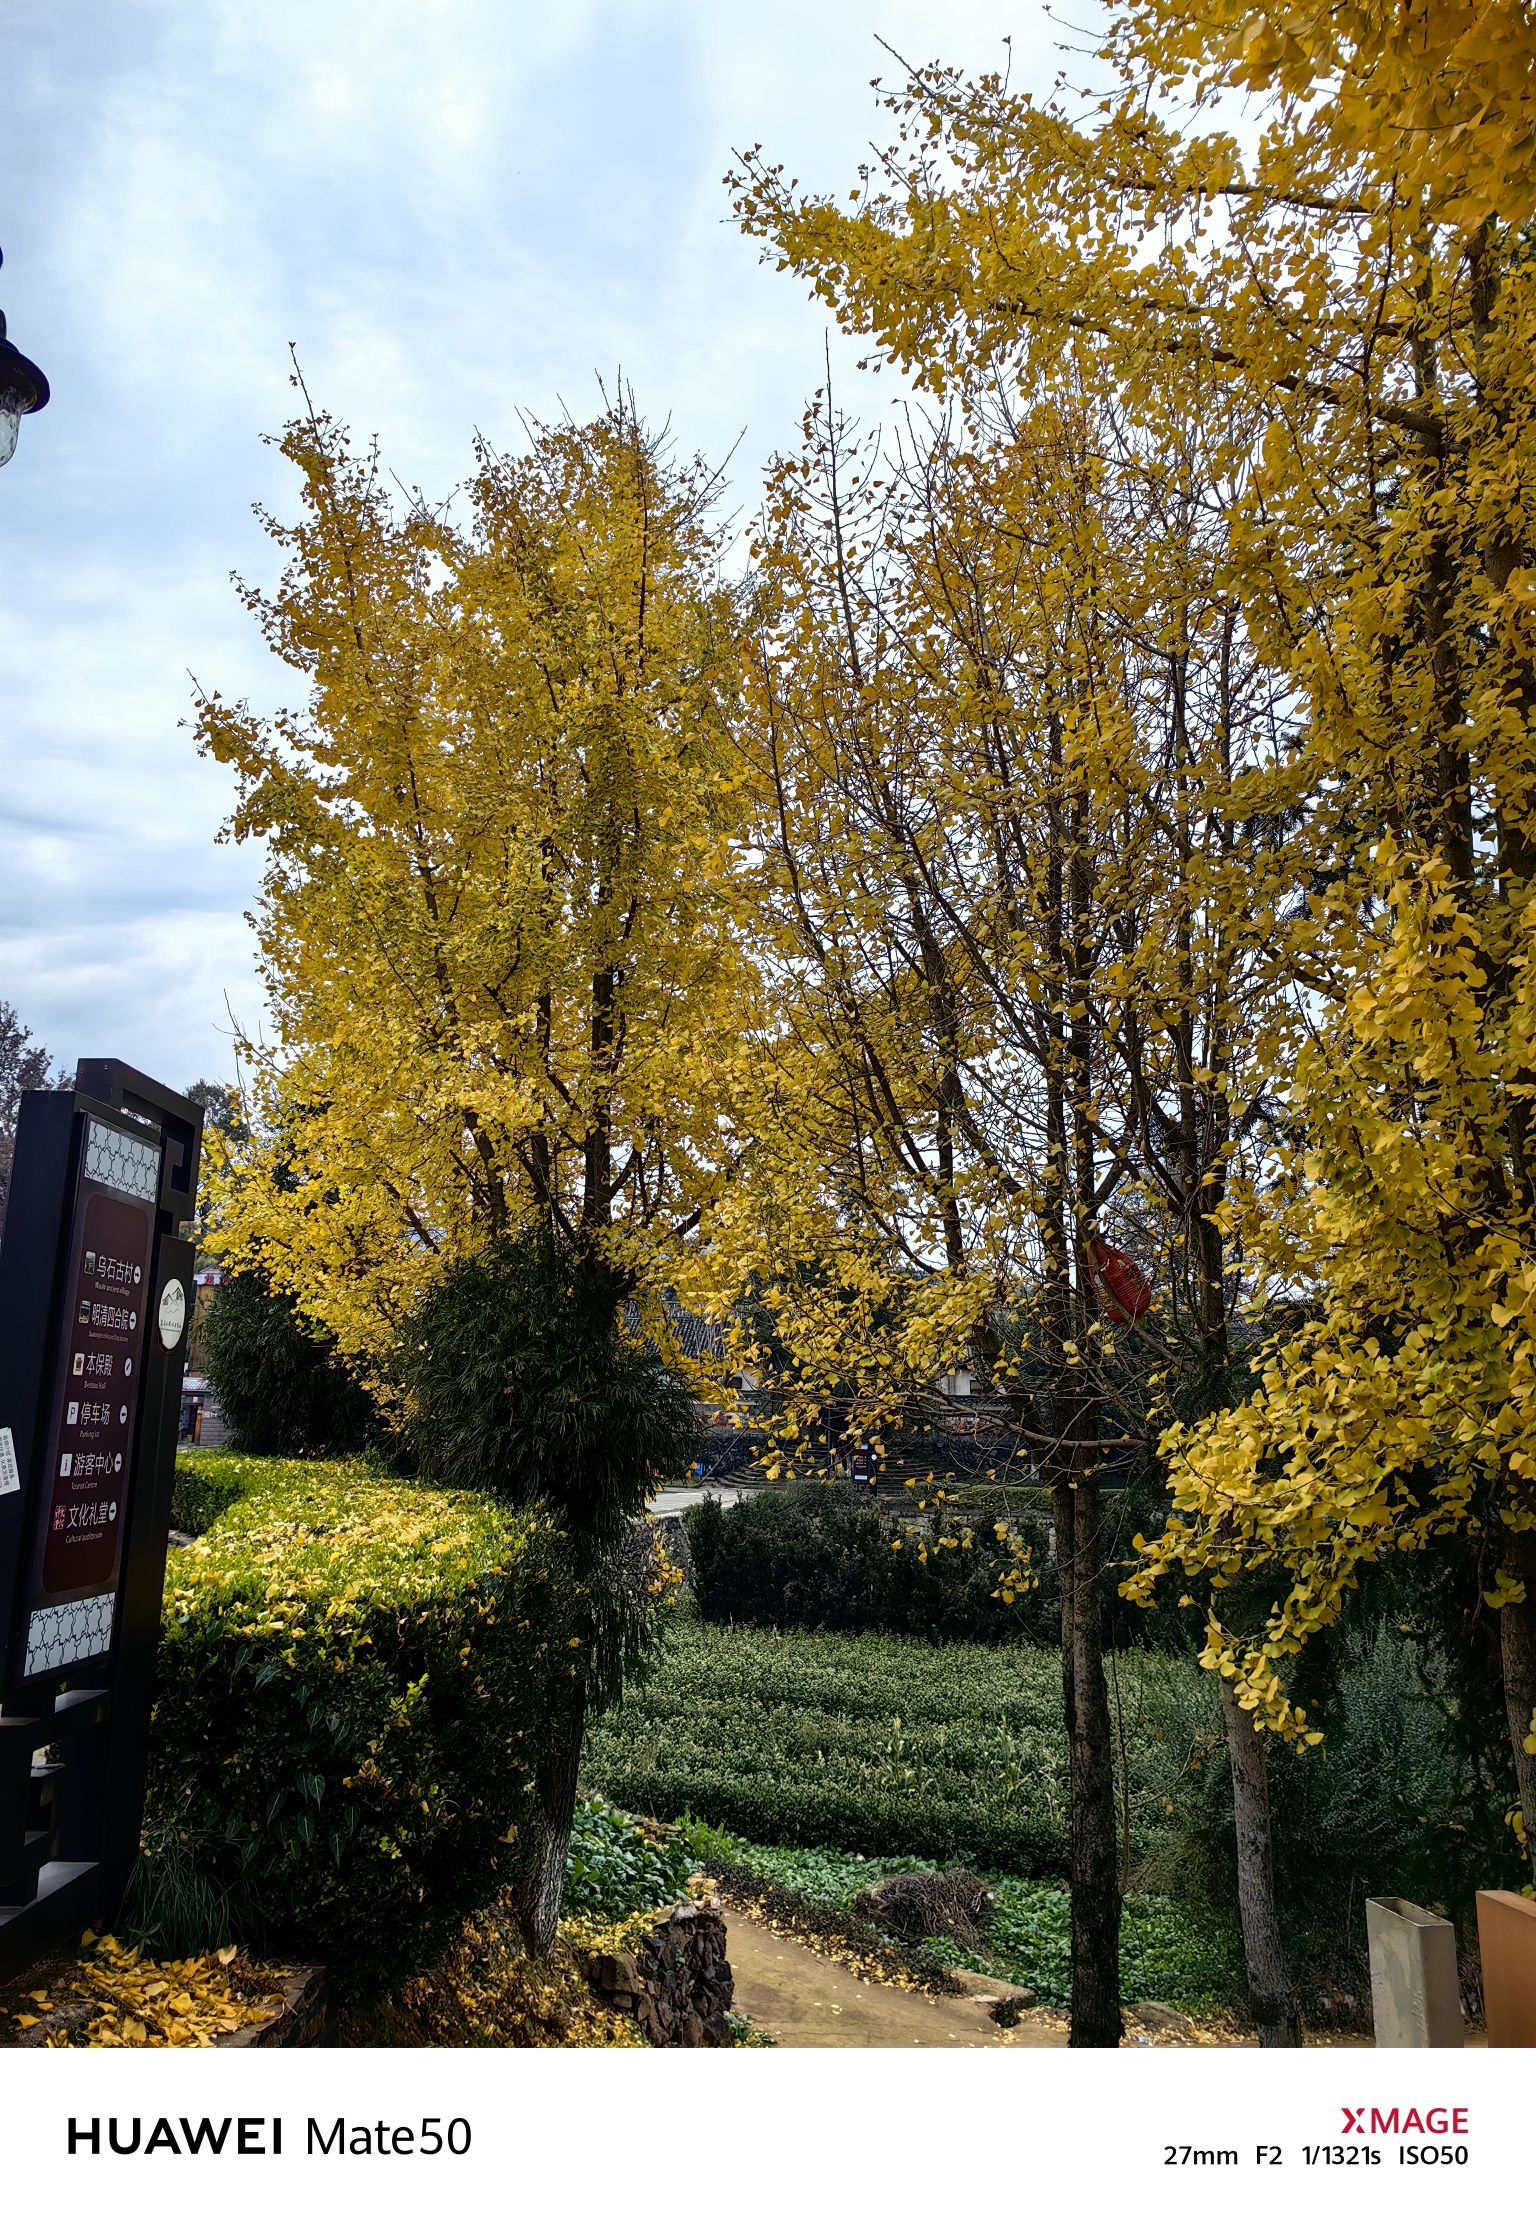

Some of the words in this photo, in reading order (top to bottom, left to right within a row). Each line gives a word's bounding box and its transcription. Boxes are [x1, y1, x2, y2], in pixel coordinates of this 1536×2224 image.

[97, 1254, 133, 1284] 乌石古村
[92, 1303, 129, 1330] 明清四合院
[86, 1352, 113, 1376] 本保殿
[80, 1402, 111, 1426] 停车场
[73, 1451, 114, 1477] 游客中心
[67, 1501, 109, 1529] 文化礼堂
